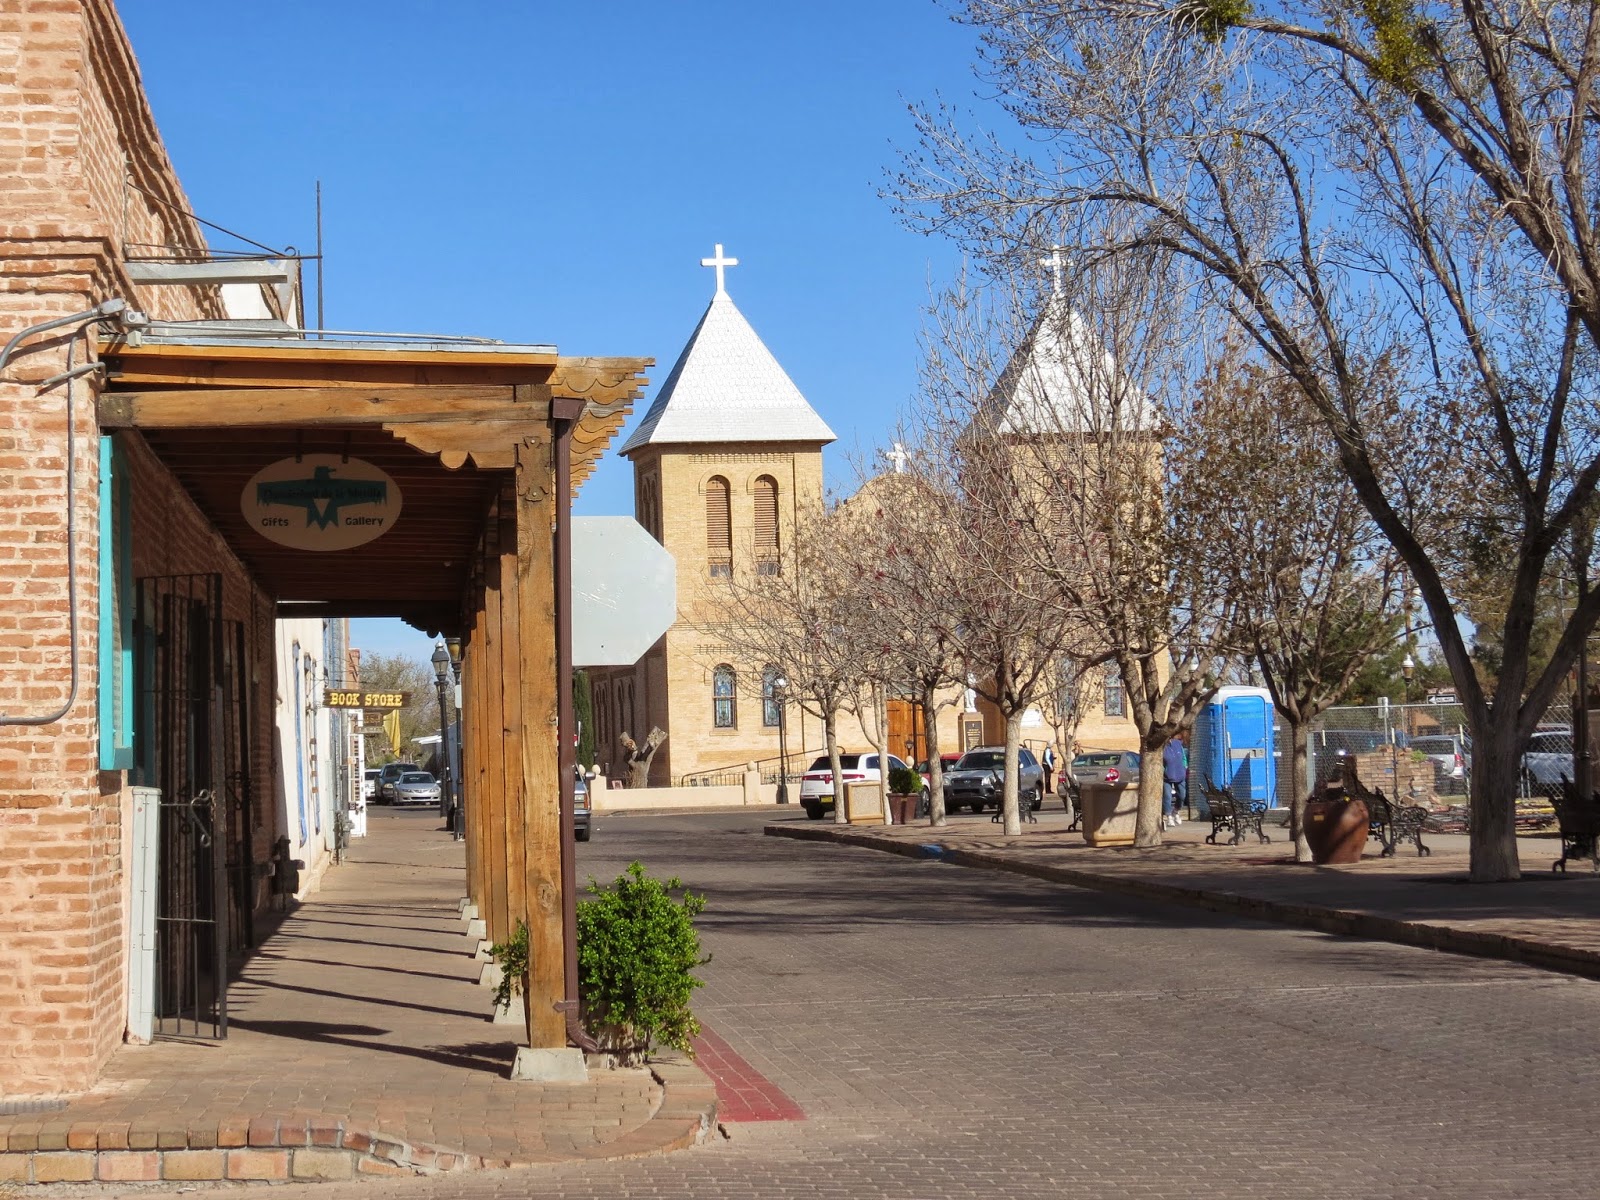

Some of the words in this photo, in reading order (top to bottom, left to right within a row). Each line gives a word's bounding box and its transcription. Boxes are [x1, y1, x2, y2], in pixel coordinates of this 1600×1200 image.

[261, 517, 289, 527] Gifts
[345, 517, 384, 527] Gallery
[330, 693, 360, 705] BOOK
[365, 694, 402, 706] STORE
